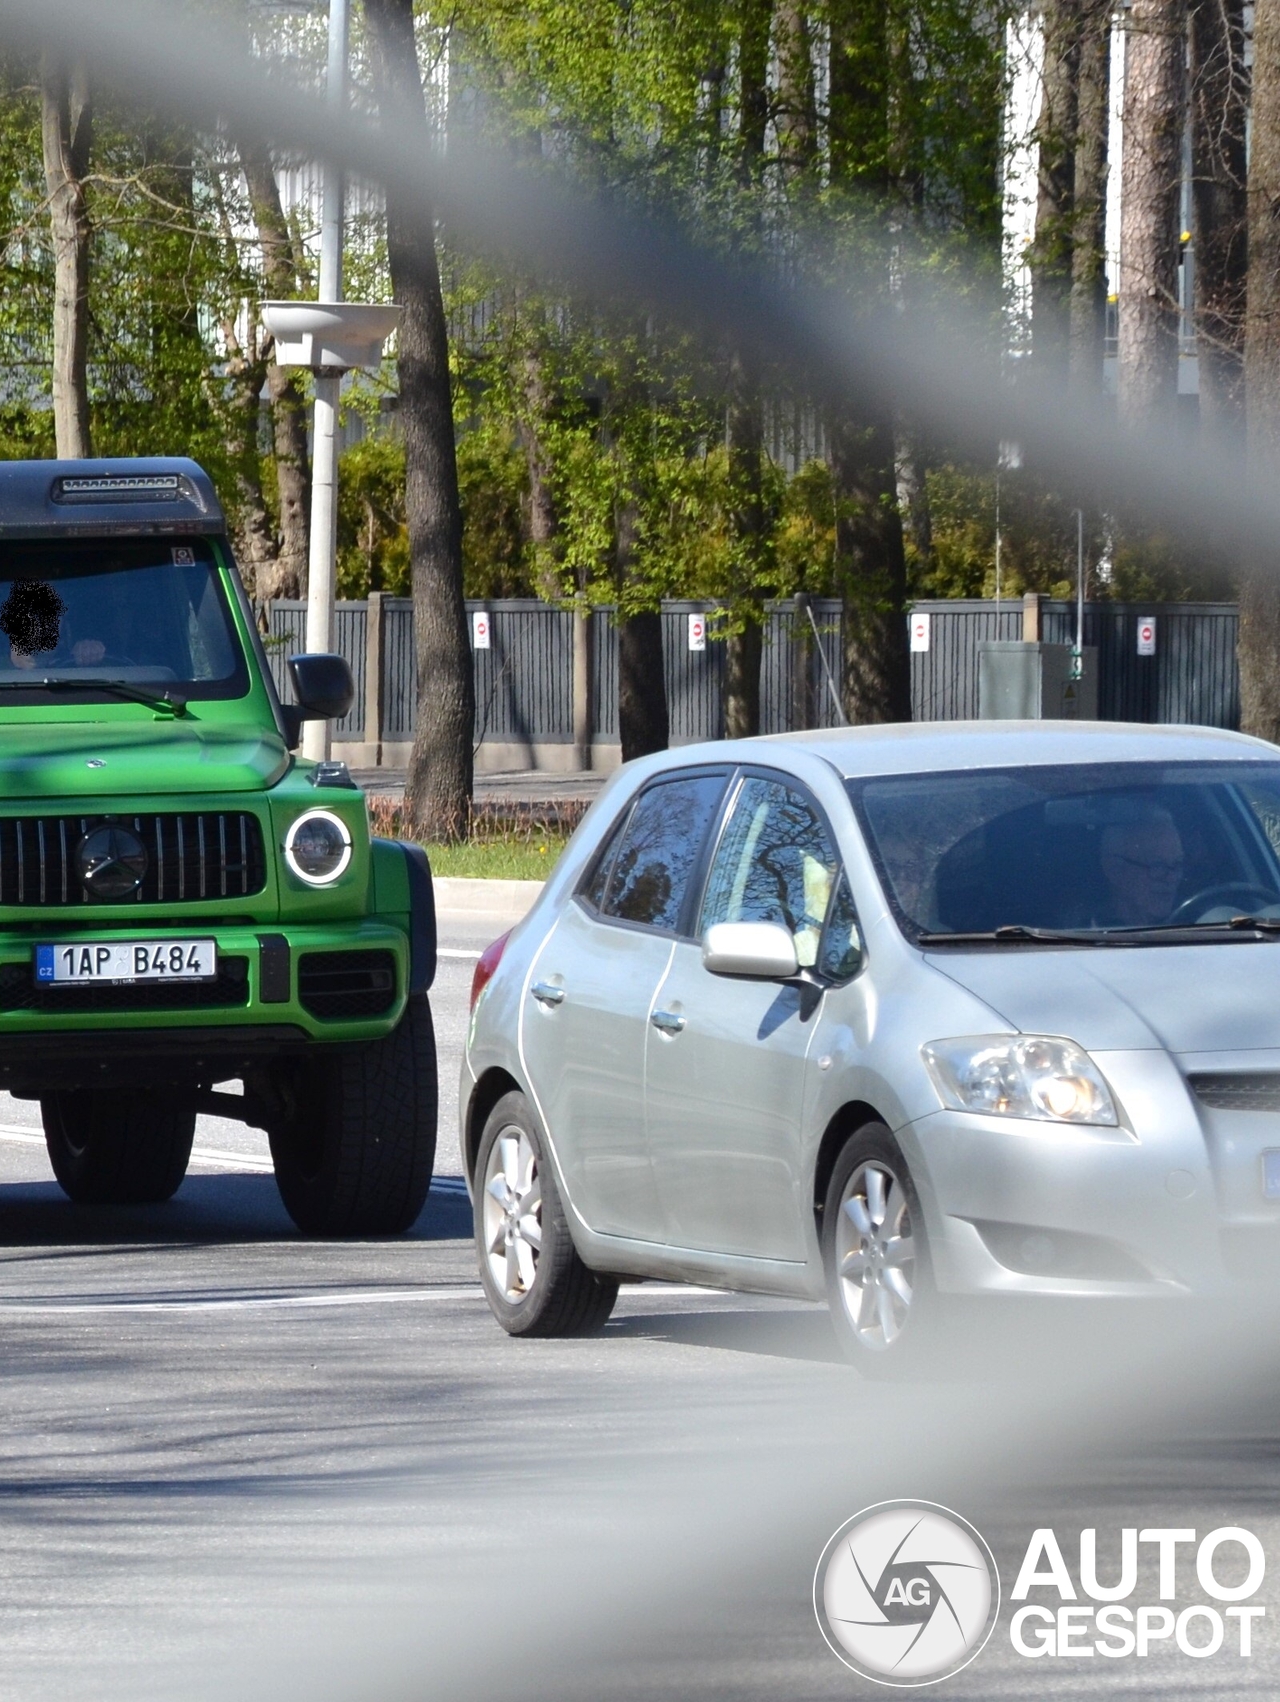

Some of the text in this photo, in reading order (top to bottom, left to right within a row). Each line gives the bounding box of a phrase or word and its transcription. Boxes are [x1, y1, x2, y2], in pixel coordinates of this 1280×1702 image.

[62, 945, 201, 975] 1AP B484
[39, 967, 52, 976] CZ
